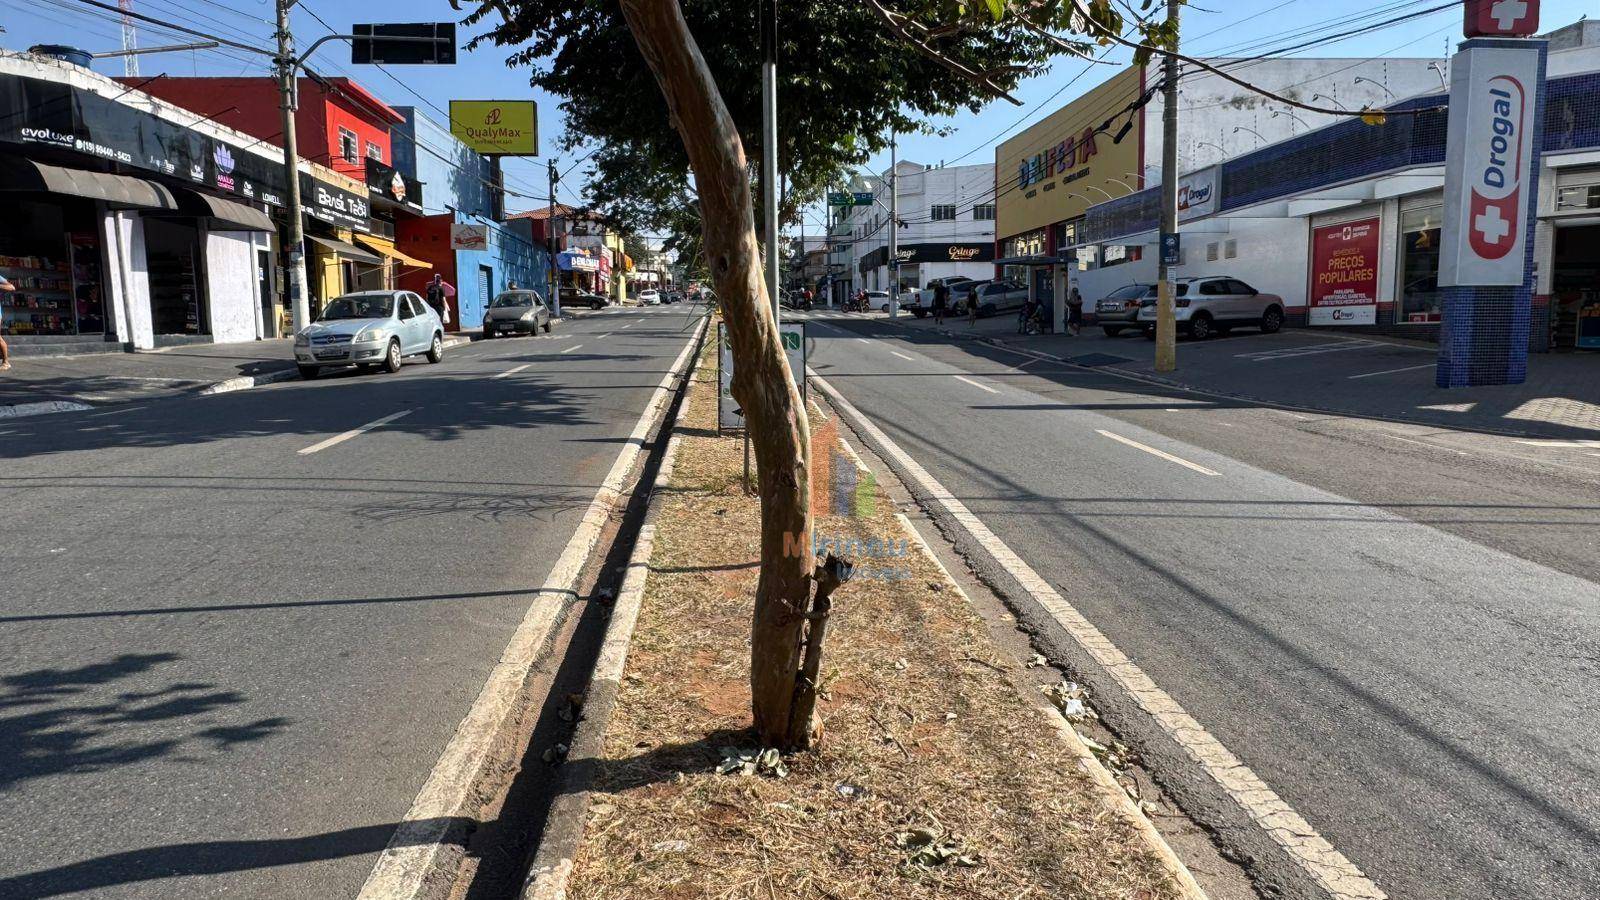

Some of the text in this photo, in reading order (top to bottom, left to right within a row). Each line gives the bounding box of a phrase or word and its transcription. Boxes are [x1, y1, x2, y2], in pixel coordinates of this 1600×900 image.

[21, 127, 74, 142] evoluxe
[466, 126, 521, 139] QualyMax
[1483, 88, 1514, 189] Drogal
[1328, 255, 1365, 271] PREÇOS
[1319, 268, 1374, 284] POPULARES
